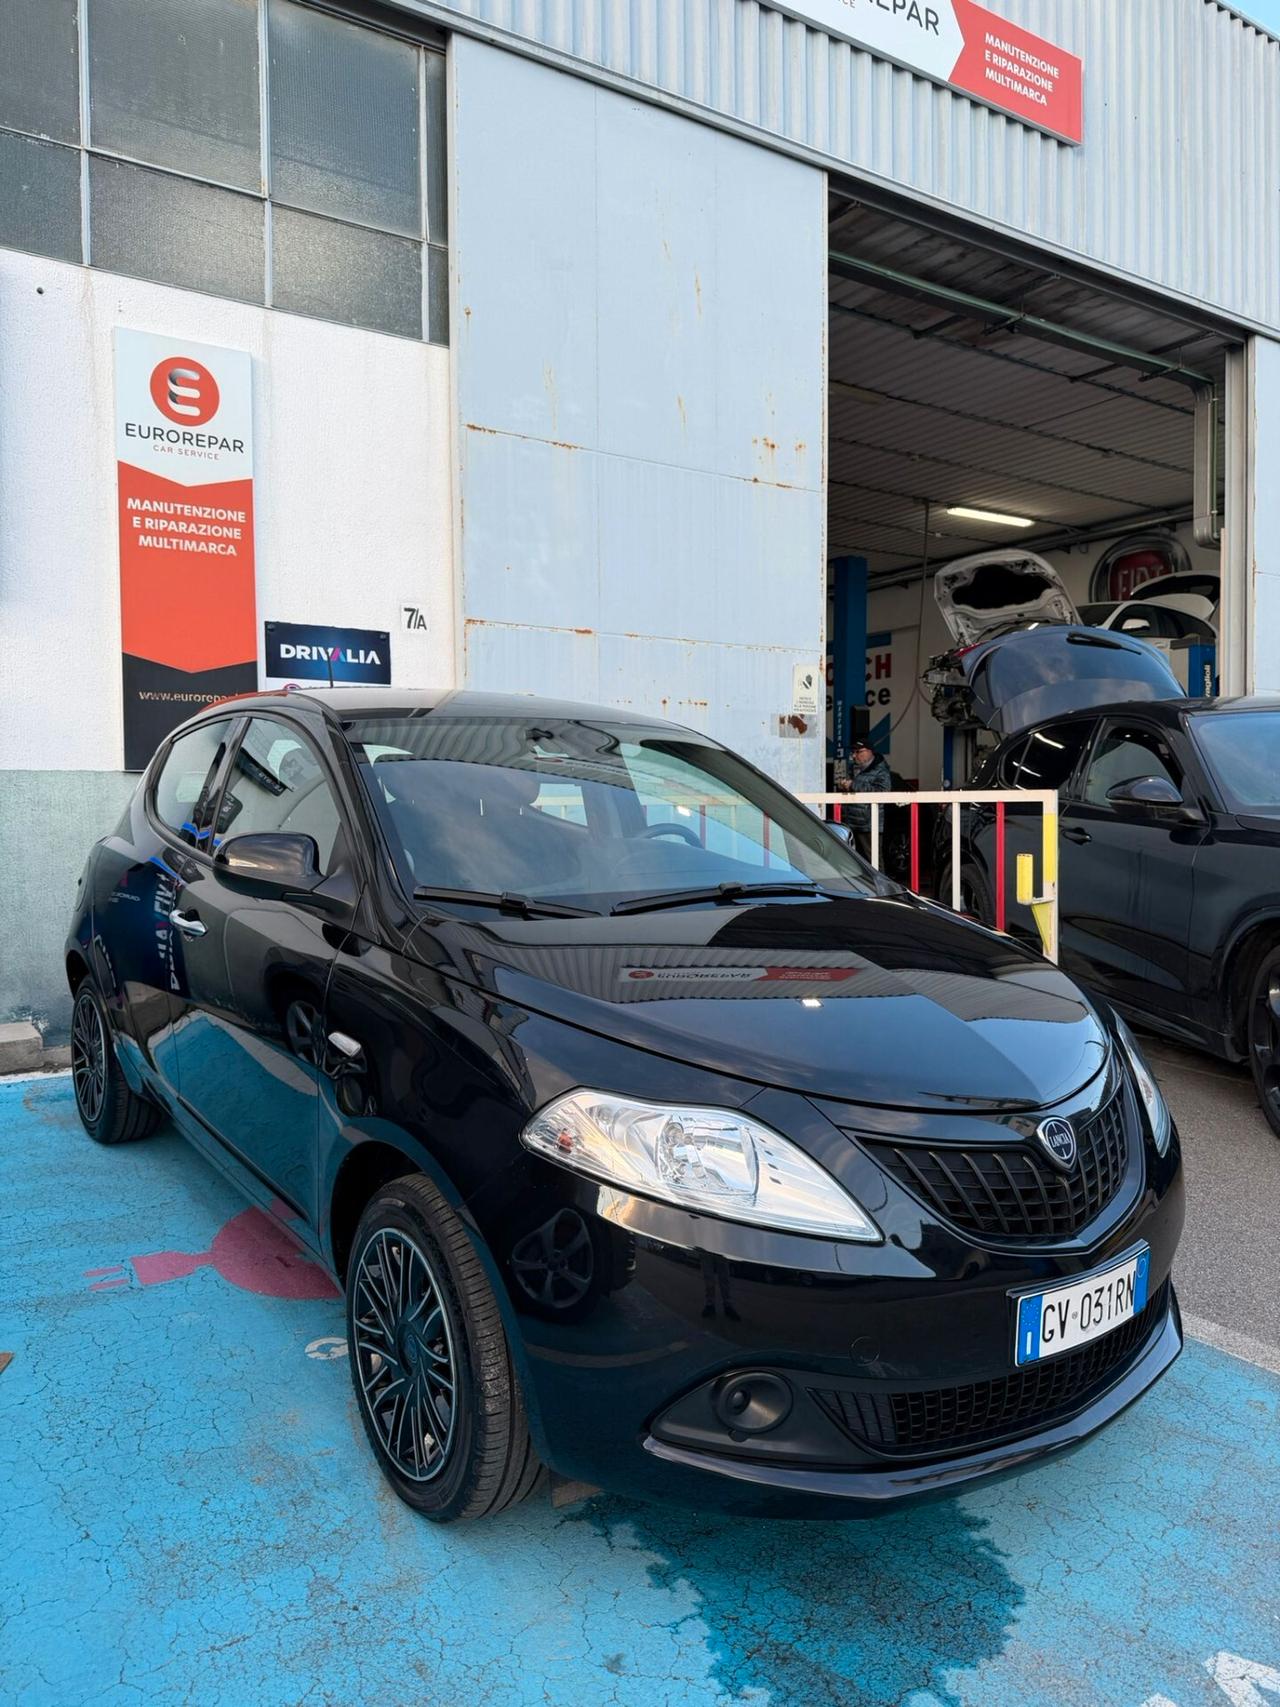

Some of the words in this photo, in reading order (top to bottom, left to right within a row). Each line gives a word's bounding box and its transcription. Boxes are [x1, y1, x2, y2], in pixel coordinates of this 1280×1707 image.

[985, 32, 1059, 79] MANUTENZIONE
[984, 50, 991, 61] E
[992, 53, 1053, 92] RIPARAZIONE
[985, 67, 1047, 106] MULTIMARCA
[125, 422, 244, 453] EUROREPAR
[153, 444, 174, 454] CAR
[178, 448, 220, 460] SERVICE
[127, 498, 246, 523] MANUTENZIONE
[132, 516, 142, 528] E
[144, 517, 242, 540] RIPARAZIONE
[138, 535, 237, 556] MULTIMARCA
[404, 607, 427, 630] 7/A
[279, 643, 381, 665] DRIVALIA
[1048, 1132, 1072, 1148] LANCIA
[1042, 1299, 1071, 1343] GV
[1080, 1270, 1137, 1332] 031RN
